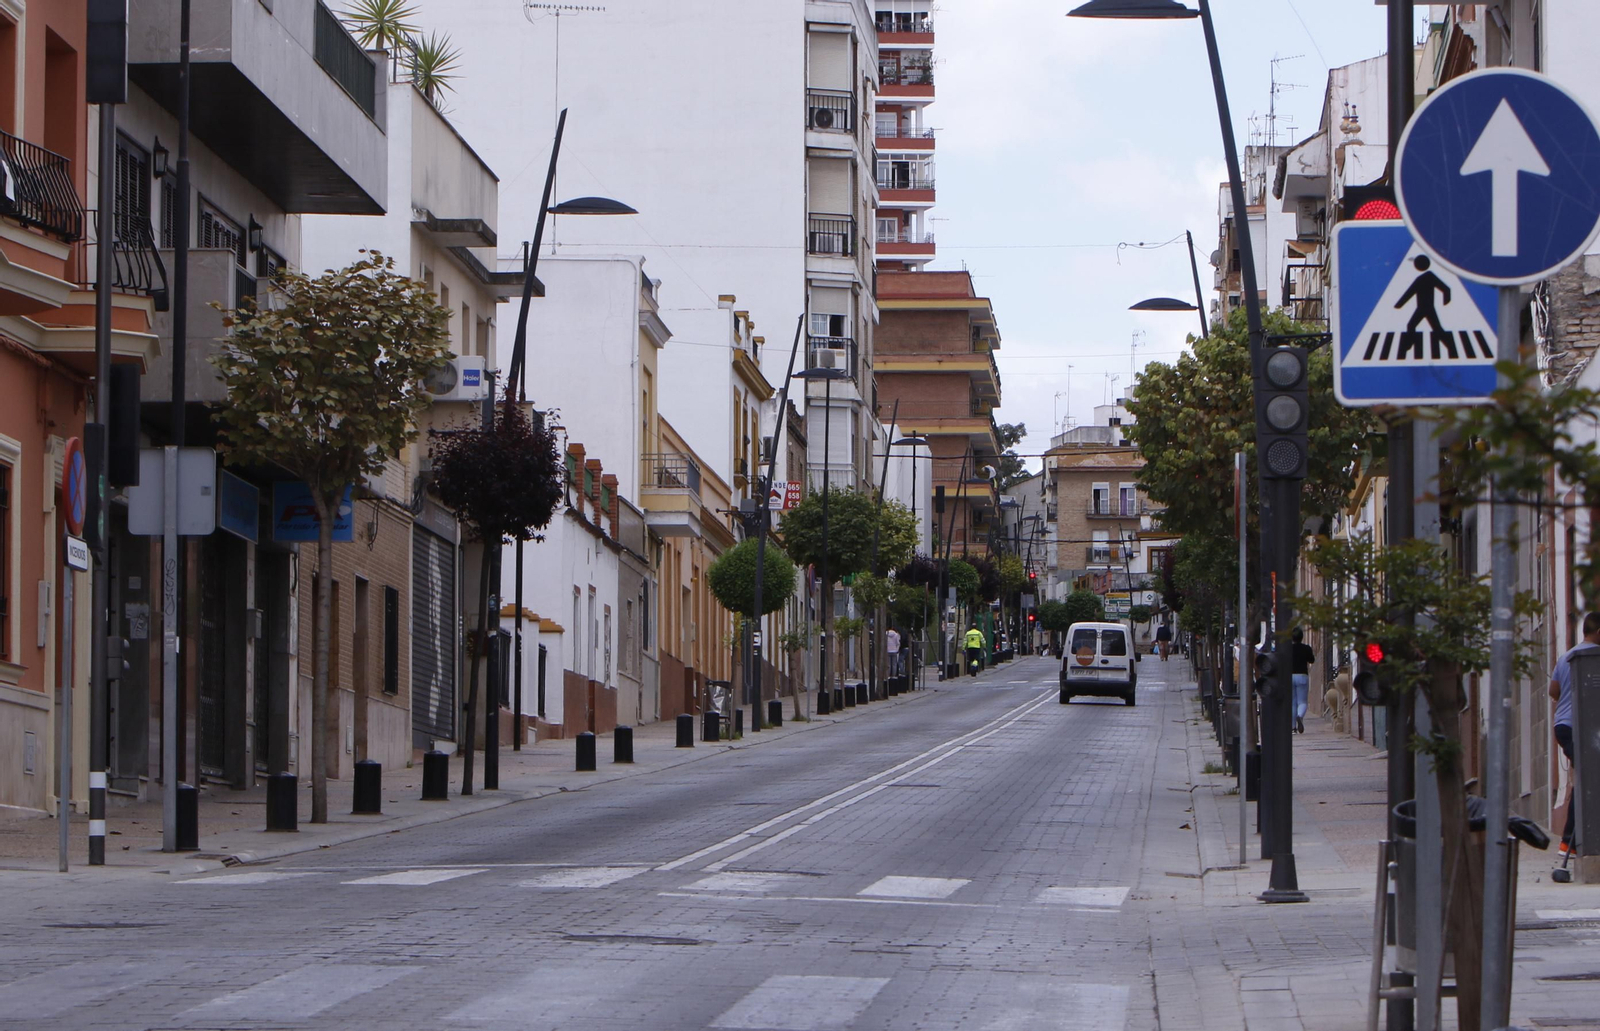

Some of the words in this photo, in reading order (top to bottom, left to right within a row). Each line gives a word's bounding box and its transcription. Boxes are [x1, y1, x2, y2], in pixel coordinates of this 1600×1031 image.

[788, 483, 800, 491] 665
[276, 522, 311, 531] Partido
[69, 545, 86, 561] INCENDIOS
